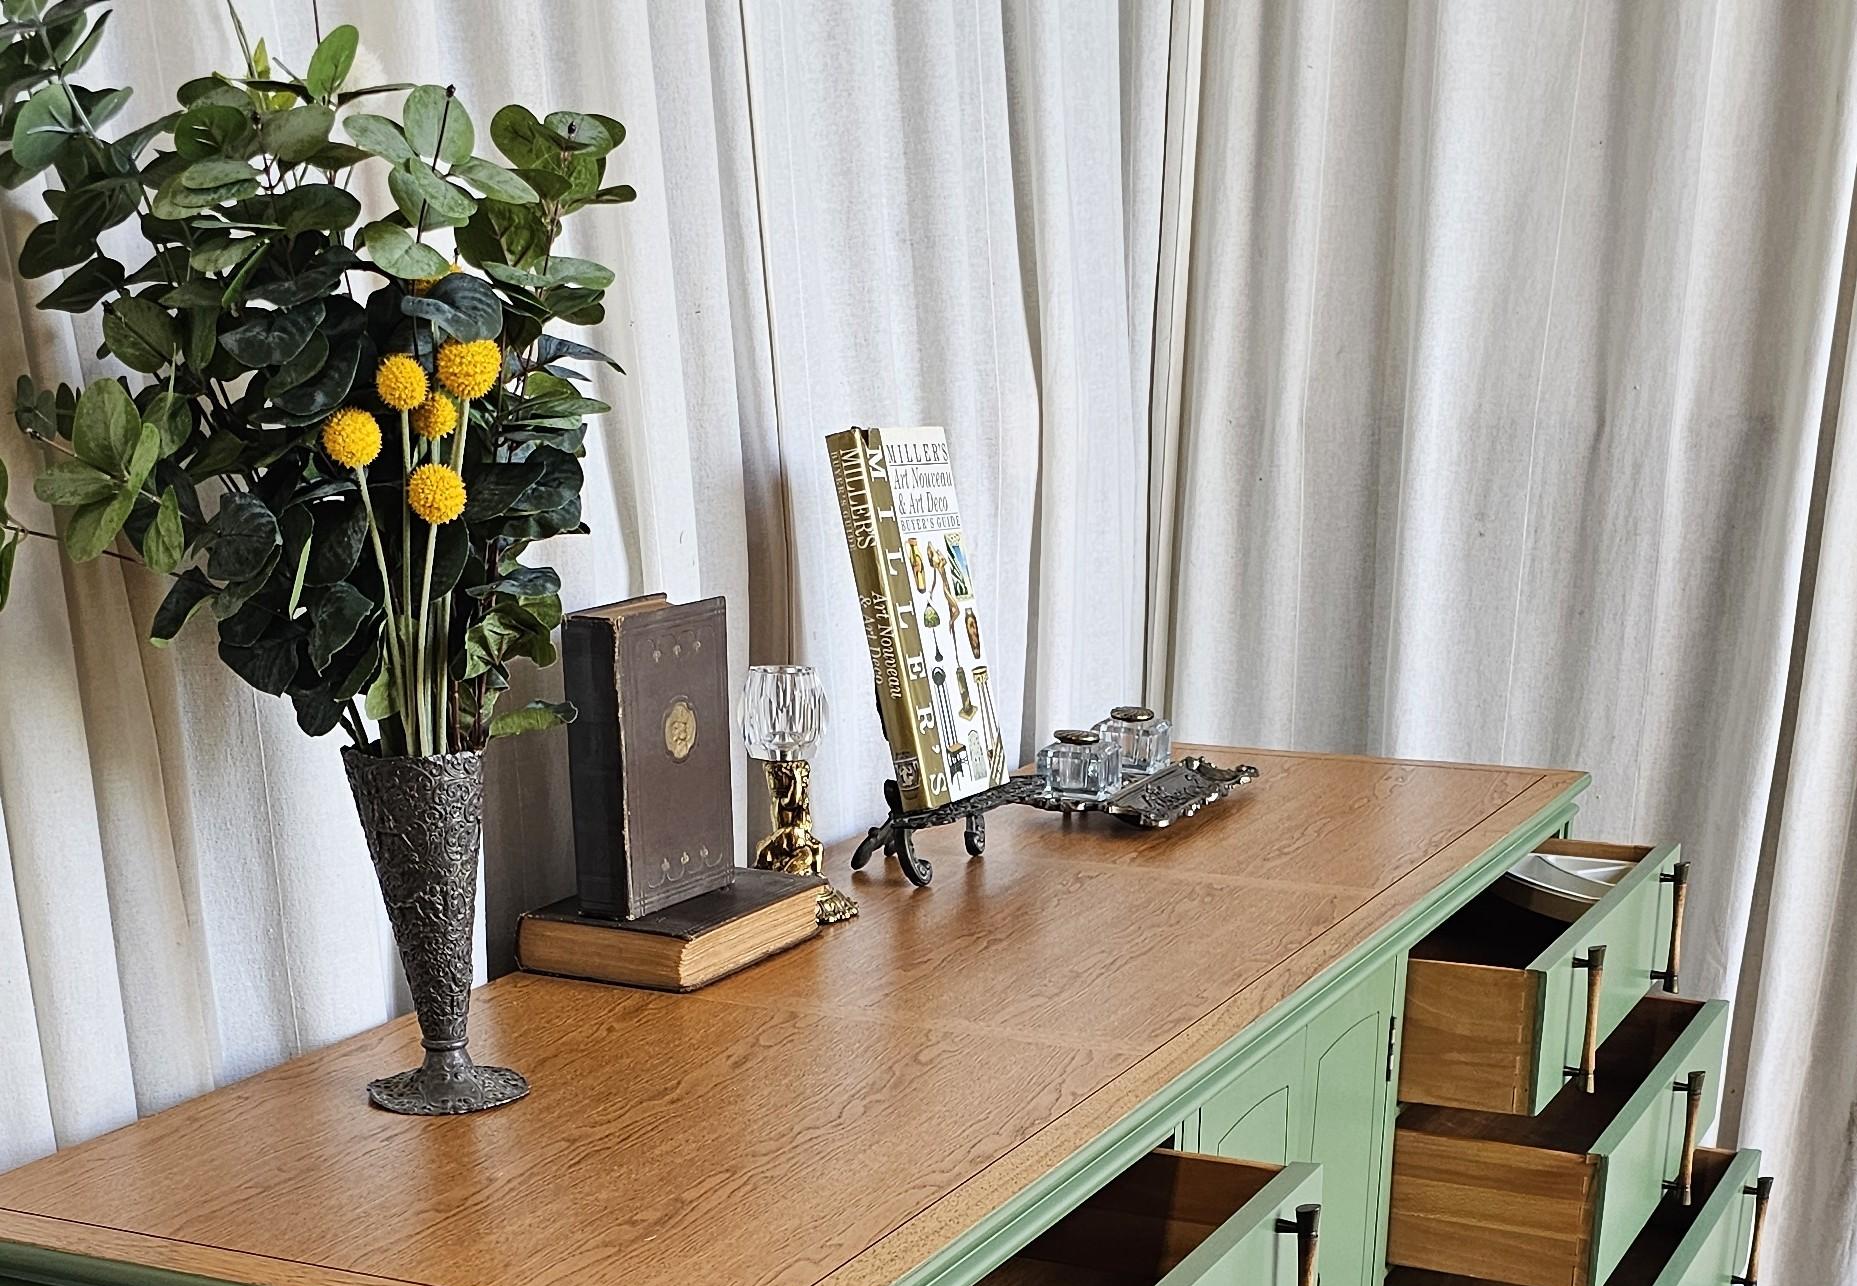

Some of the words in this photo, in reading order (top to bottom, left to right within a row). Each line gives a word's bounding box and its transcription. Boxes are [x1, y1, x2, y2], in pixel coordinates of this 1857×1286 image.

[886, 443, 949, 464] MILLER'S
[894, 468, 909, 490] Art
[911, 467, 952, 488] Nouveau
[840, 447, 877, 549] MILLER'S
[899, 493, 906, 515] &
[909, 493, 924, 514] Art
[926, 491, 948, 513] Deco
[901, 518, 934, 531] BUYER'S
[937, 515, 960, 529] GUIDE
[872, 591, 890, 620] Art
[867, 445, 948, 796] MILLER'S
[863, 614, 877, 640] Art
[870, 646, 882, 685] Deco
[878, 624, 902, 700] Nouveau
